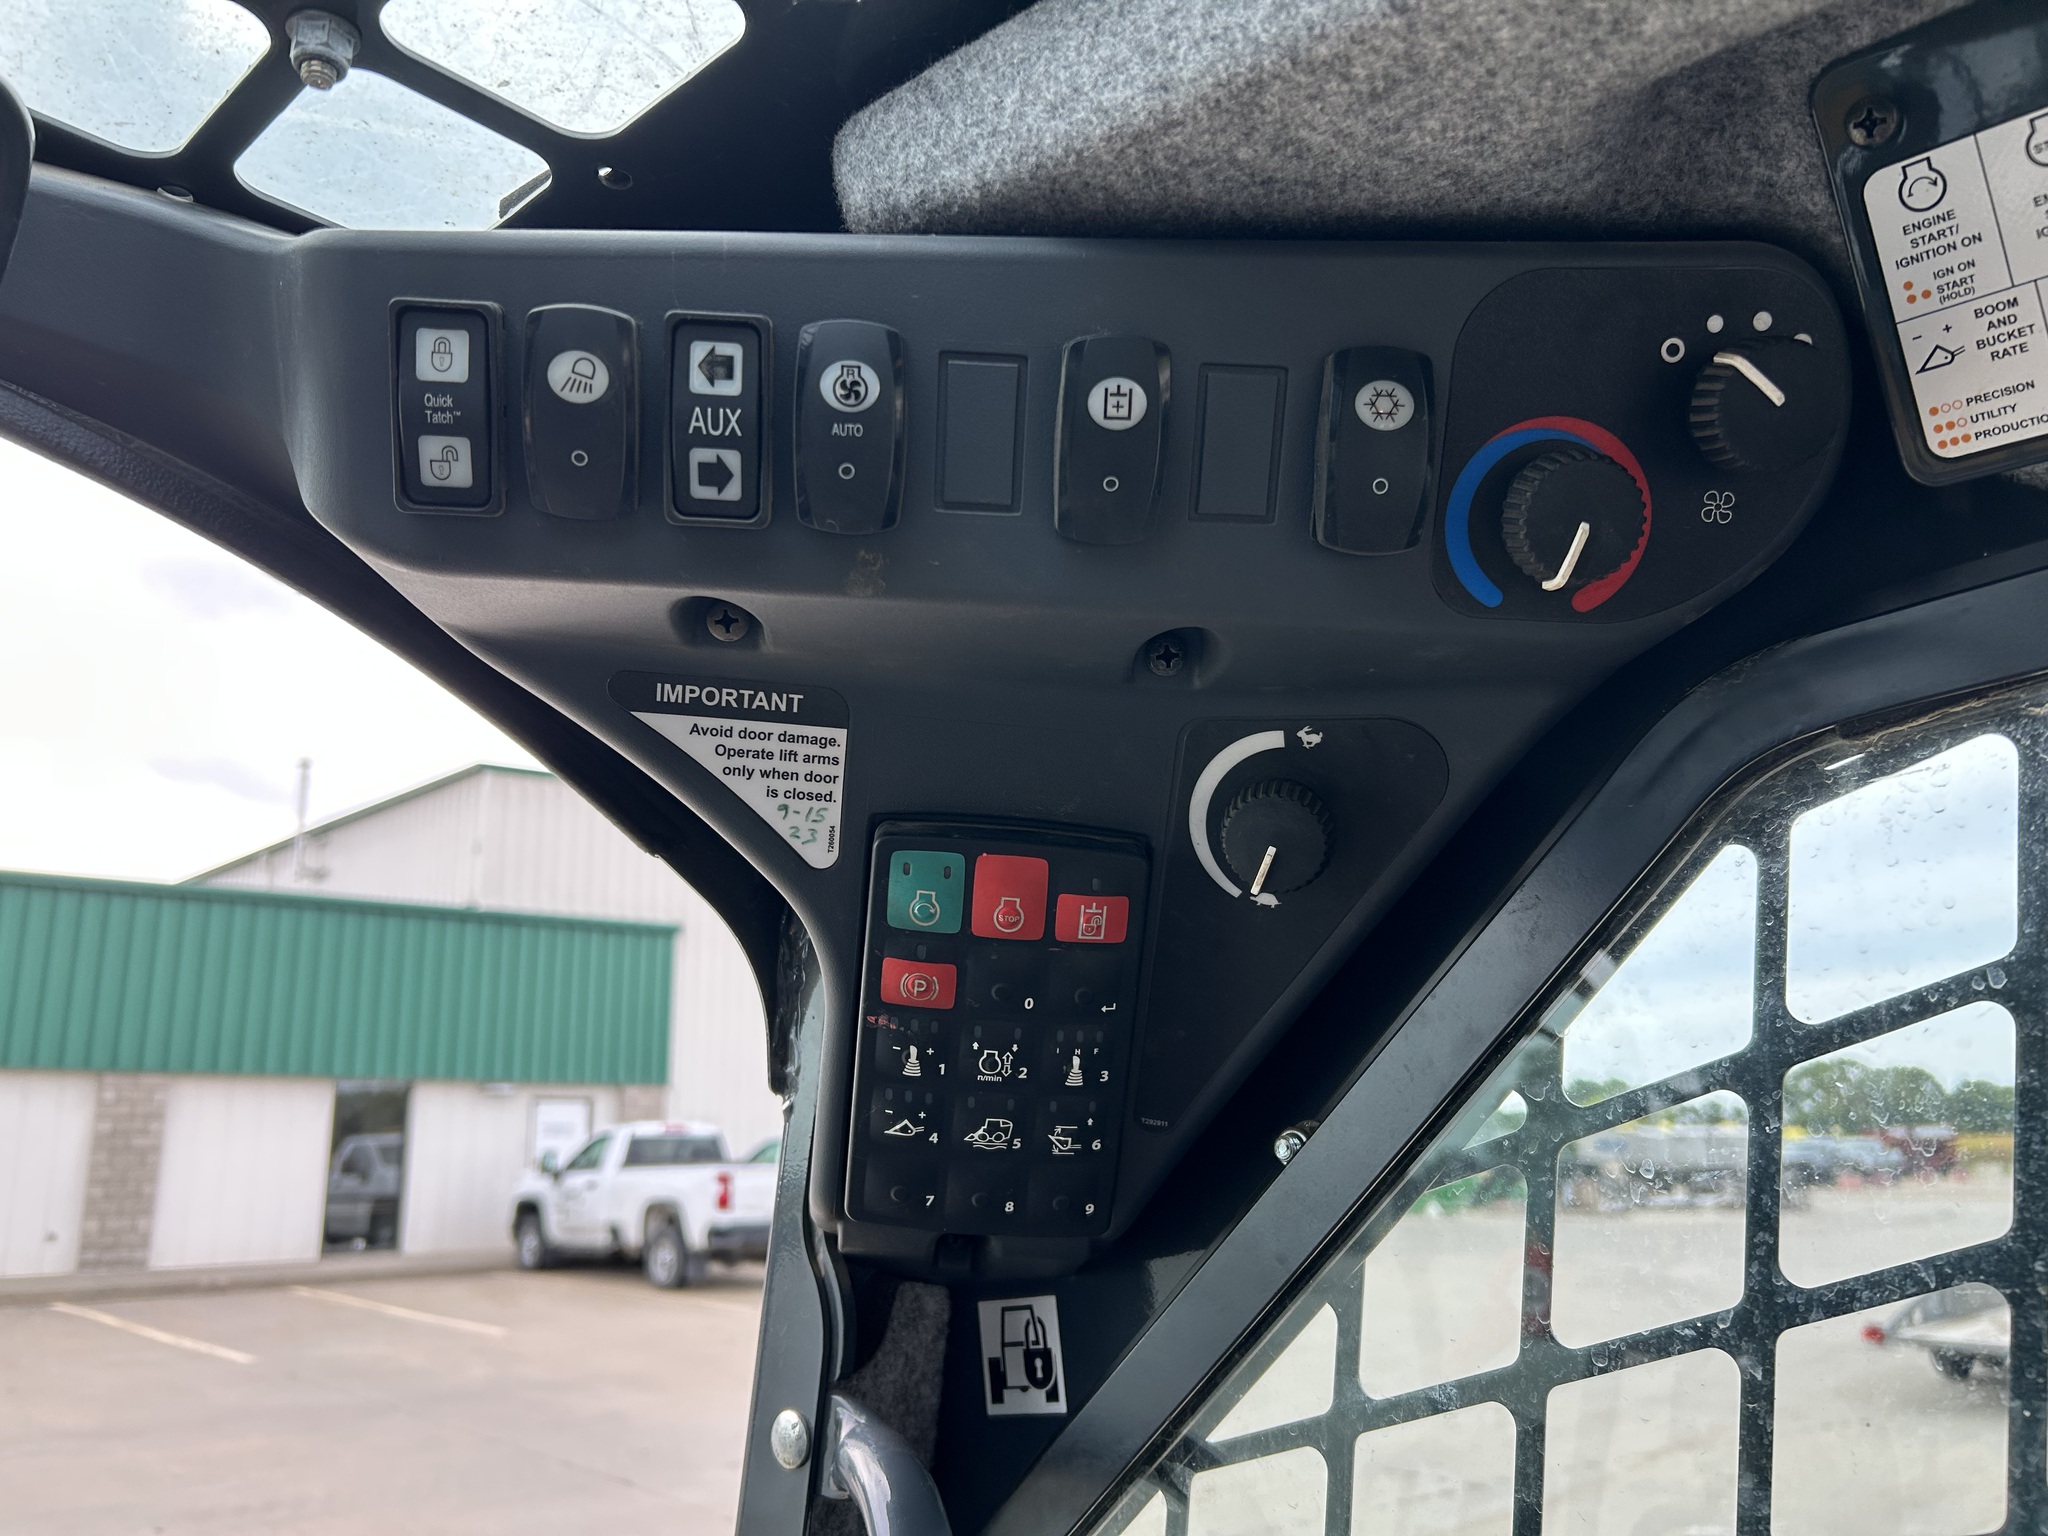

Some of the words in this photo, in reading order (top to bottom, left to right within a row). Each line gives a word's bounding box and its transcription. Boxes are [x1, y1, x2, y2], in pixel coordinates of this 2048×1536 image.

[1902, 209, 1957, 236] ENGINE
[1910, 223, 1960, 249] START/
[1895, 240, 1957, 270] IGNITION
[1961, 232, 1983, 248] ON
[1933, 264, 1955, 280] IGN
[1957, 259, 1976, 273] ON
[1936, 275, 1975, 294] START
[1939, 286, 1976, 305] (HOLD)
[1973, 297, 2019, 319] BOOM
[1987, 313, 2018, 331] AND
[1975, 323, 2036, 350] BUCKET
[1990, 342, 2030, 361] RATE
[424, 393, 453, 407] Quick
[1965, 380, 2035, 407] PRECISION
[688, 407, 742, 436] AUX
[1970, 403, 2018, 424] UTILITY
[832, 423, 863, 437] AUTO
[1974, 414, 2048, 441] PRODUCTIO
[655, 683, 804, 713] IMPORTANT
[689, 723, 733, 739] Avoid
[737, 727, 773, 742] door
[777, 730, 841, 749] damage.
[714, 744, 774, 760] Operate
[779, 749, 799, 762] lift
[802, 753, 840, 766] arms
[722, 765, 755, 780] only
[759, 768, 799, 781] when
[804, 772, 839, 784] door
[766, 786, 779, 798] is
[783, 787, 837, 803] closed.
[998, 913, 1020, 923] STOP
[913, 979, 926, 996] P
[1024, 998, 1034, 1010] 0
[938, 1063, 946, 1075] 1
[977, 1073, 1002, 1082] n/min
[1018, 1067, 1028, 1079] 2
[1099, 1070, 1109, 1082] 3
[928, 1132, 939, 1144] 4
[1012, 1138, 1021, 1149] 5
[1091, 1139, 1102, 1150] 6
[925, 1195, 935, 1206] 7
[1004, 1201, 1015, 1212] 8
[1084, 1203, 1095, 1214] 9
